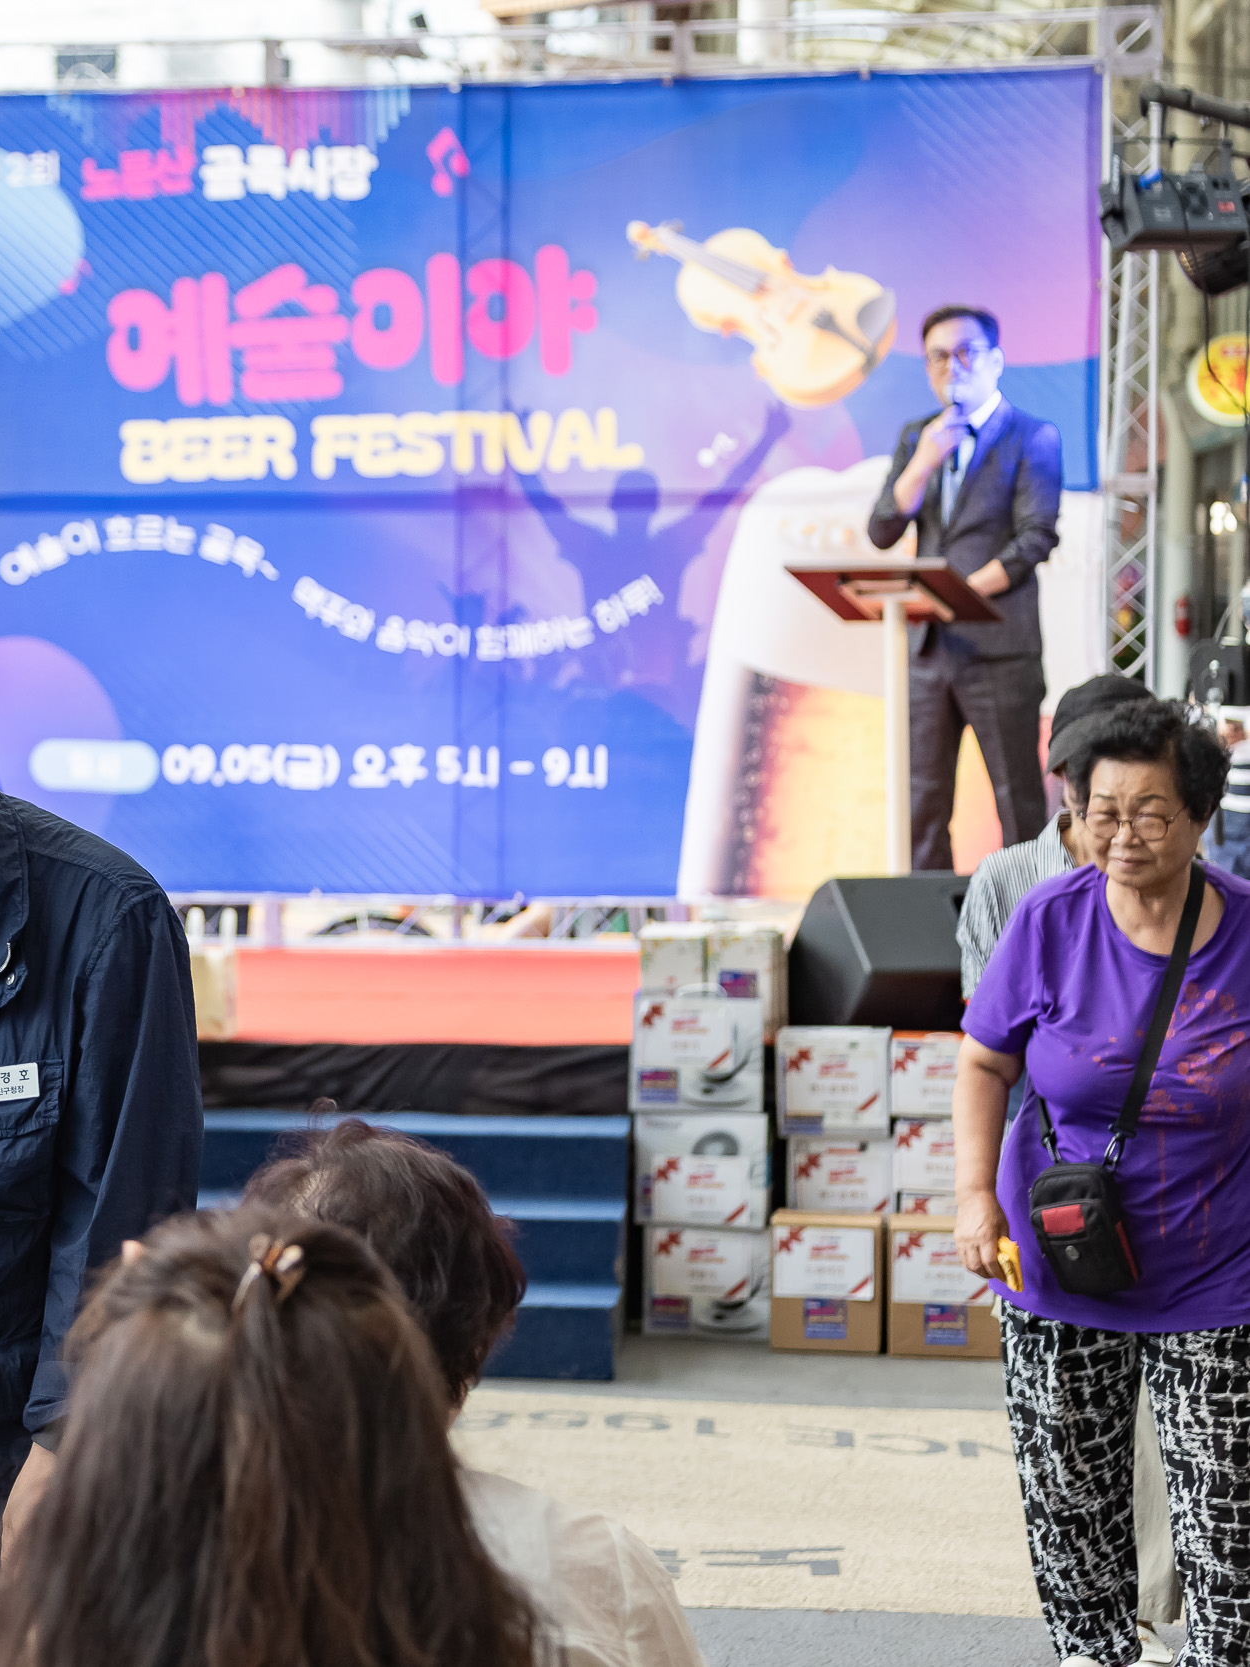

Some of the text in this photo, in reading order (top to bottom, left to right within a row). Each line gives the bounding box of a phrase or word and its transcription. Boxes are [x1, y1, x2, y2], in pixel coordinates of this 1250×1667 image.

[107, 244, 598, 406] 예술이야
[118, 406, 645, 484] BEER FESTIVAL
[161, 742, 342, 791] 09.05(금)
[348, 743, 429, 789] 오후
[435, 744, 499, 789] 5시
[541, 744, 608, 789] 9시
